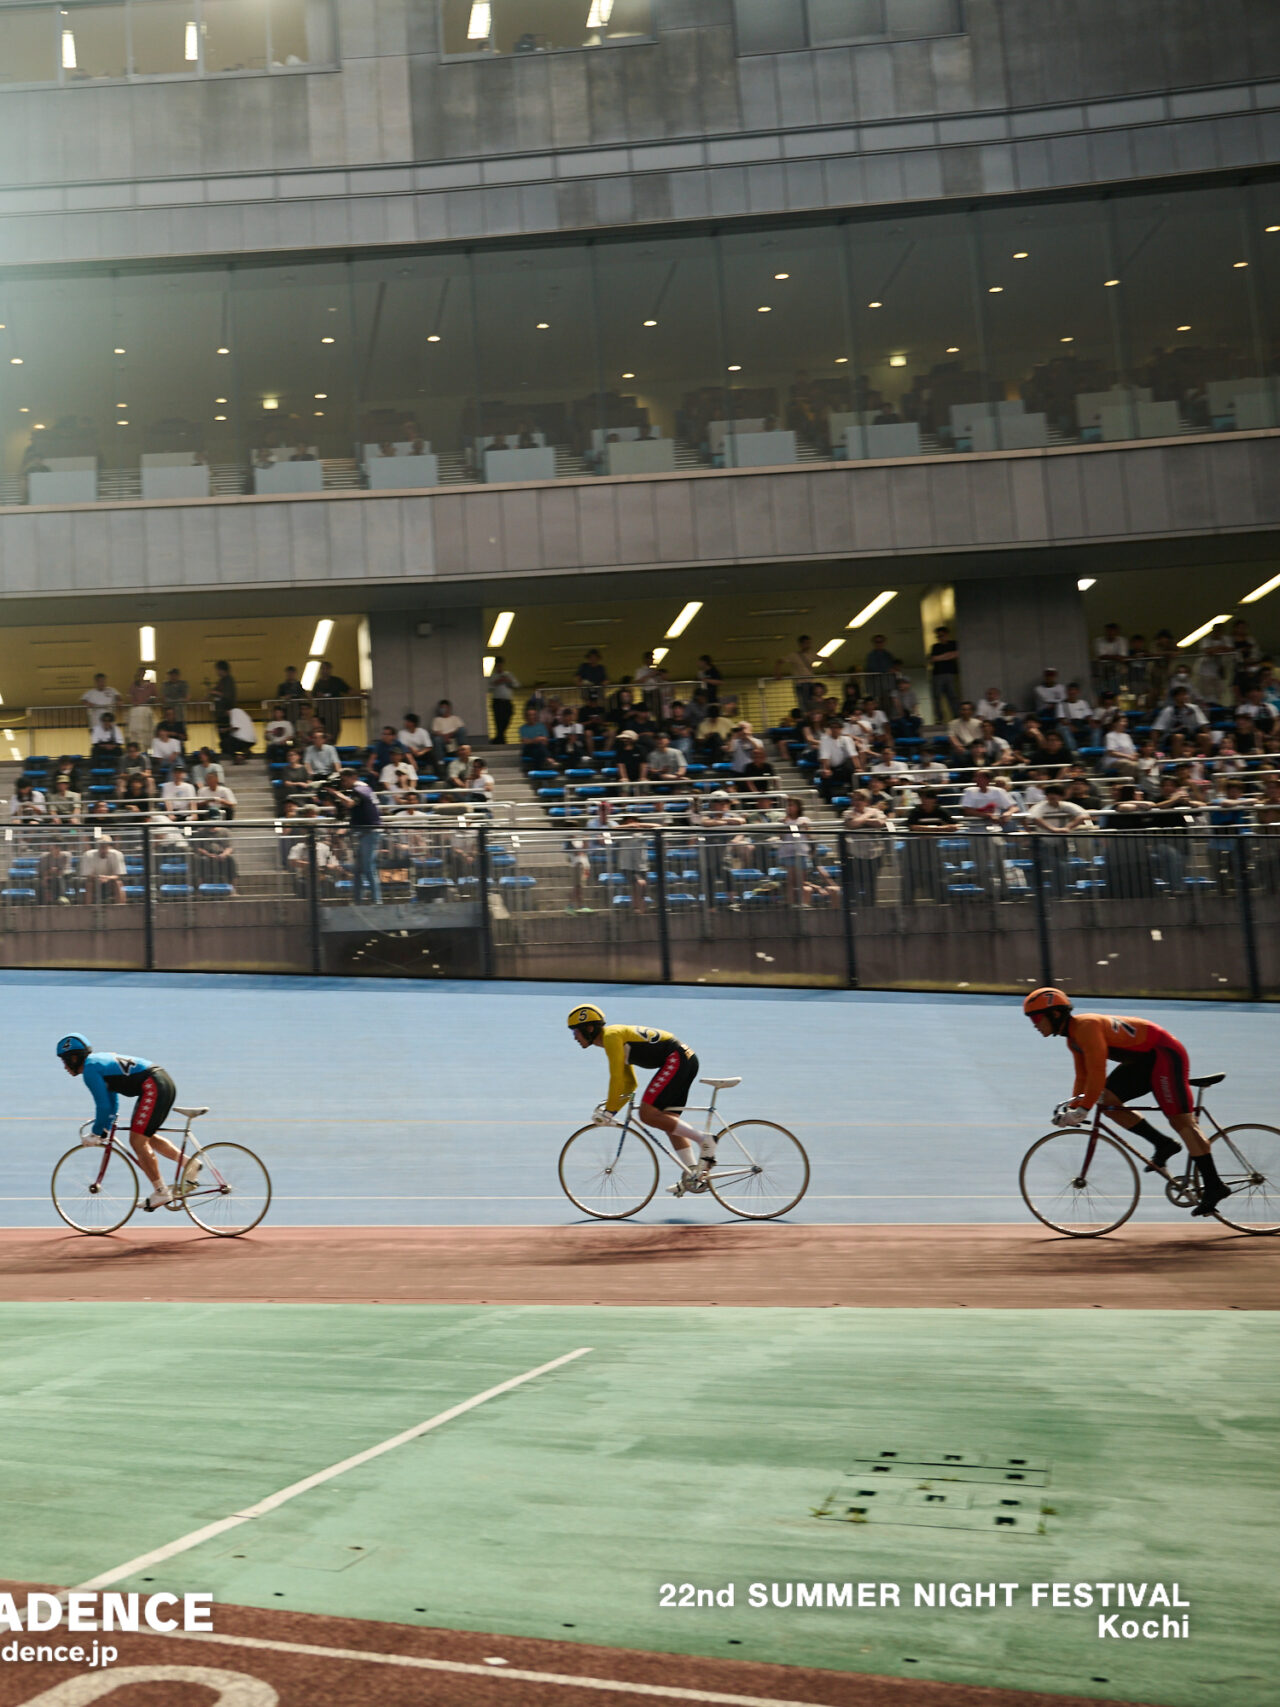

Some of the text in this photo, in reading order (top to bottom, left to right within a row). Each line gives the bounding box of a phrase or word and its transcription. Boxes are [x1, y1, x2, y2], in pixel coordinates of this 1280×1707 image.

[1043, 993, 1054, 1006] 7
[579, 1009, 588, 1021] 5
[636, 1027, 661, 1044] 5
[115, 1056, 136, 1075] 4
